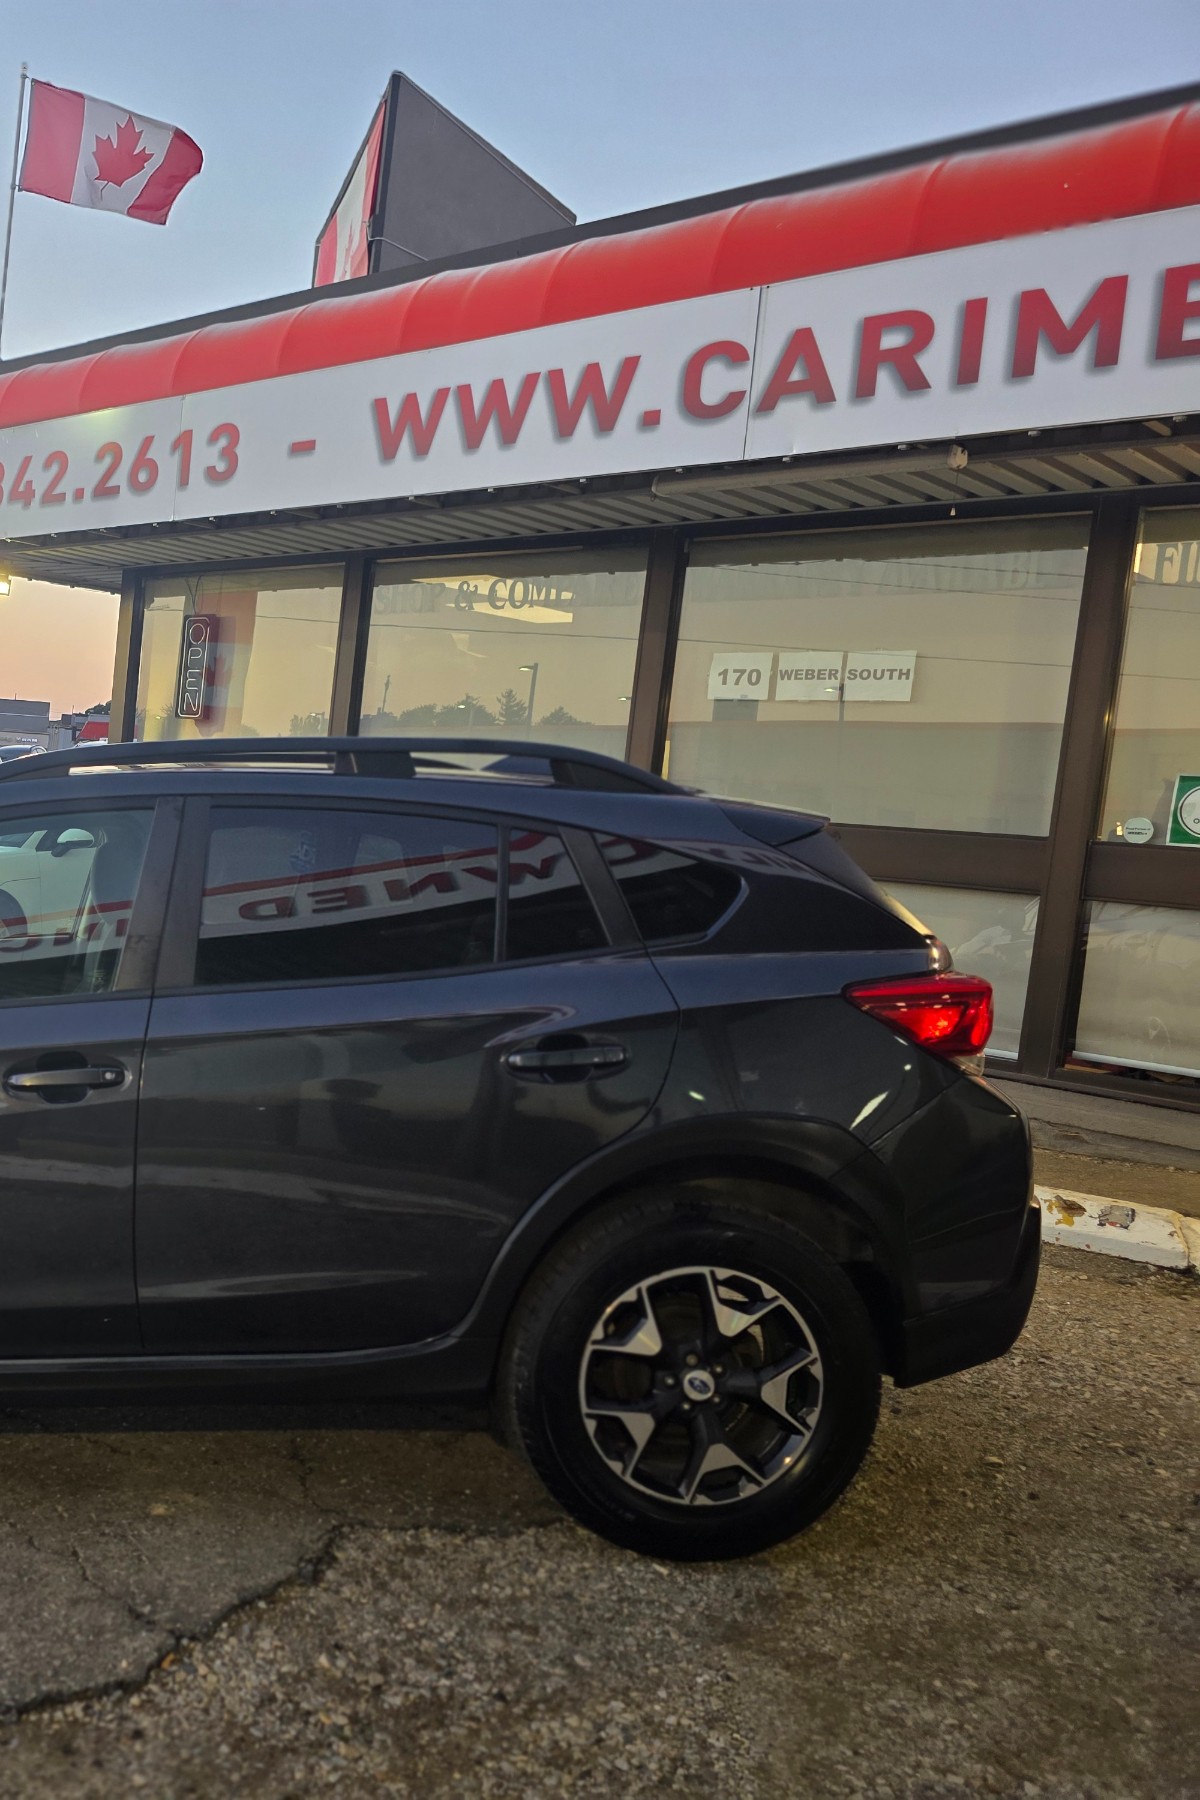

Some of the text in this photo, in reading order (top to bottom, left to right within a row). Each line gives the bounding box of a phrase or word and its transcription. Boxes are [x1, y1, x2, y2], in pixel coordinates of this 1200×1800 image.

[454, 580, 479, 611] &
[183, 623, 206, 711] OPEN
[717, 667, 911, 686] 170 WEBER SOUTH
